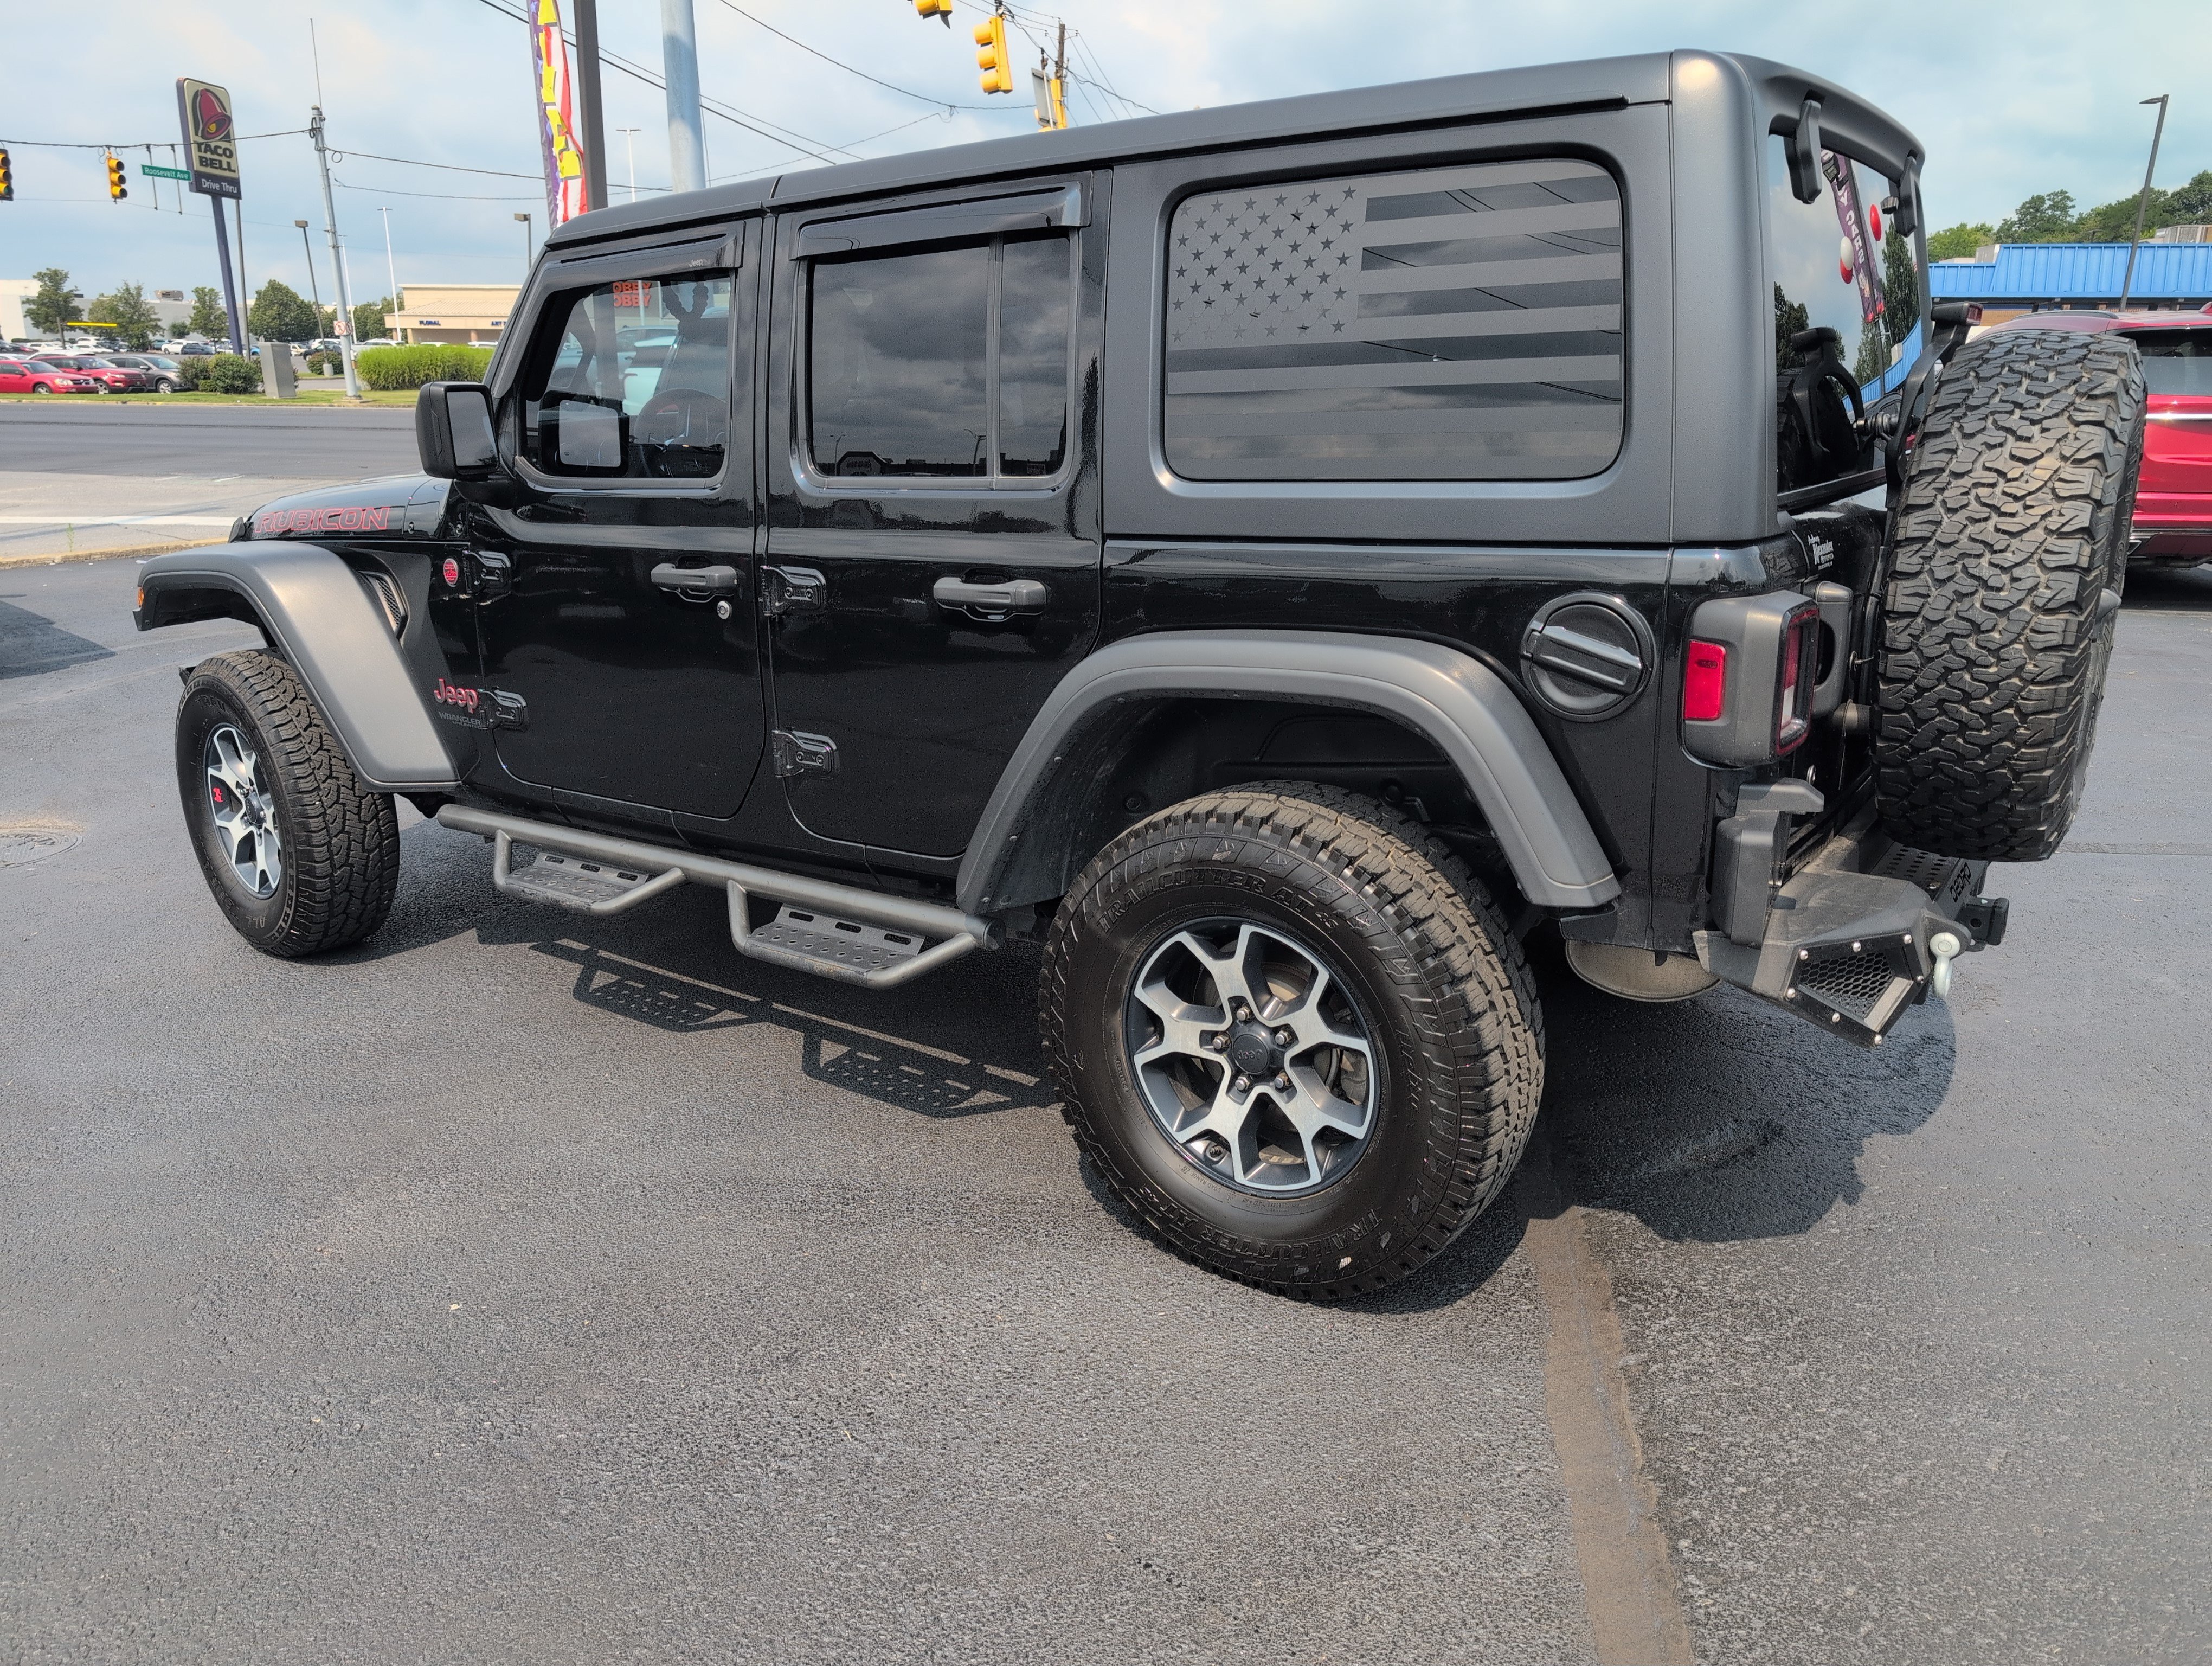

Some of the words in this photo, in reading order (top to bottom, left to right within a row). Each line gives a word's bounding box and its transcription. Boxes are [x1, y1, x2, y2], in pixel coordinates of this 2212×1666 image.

[196, 142, 233, 159] TACO
[198, 155, 236, 172] BELL
[144, 167, 176, 177] Roosevelt
[177, 171, 189, 180] Ave
[201, 178, 220, 190] Drive
[221, 182, 237, 193] Thru
[689, 259, 703, 267] Jeep
[255, 507, 390, 533] RUBICON
[434, 678, 478, 714] Jeep
[438, 711, 481, 725] WRANGLER
[1189, 1171, 1207, 1185] RANGE
[1206, 1181, 1221, 1193] LOAD
